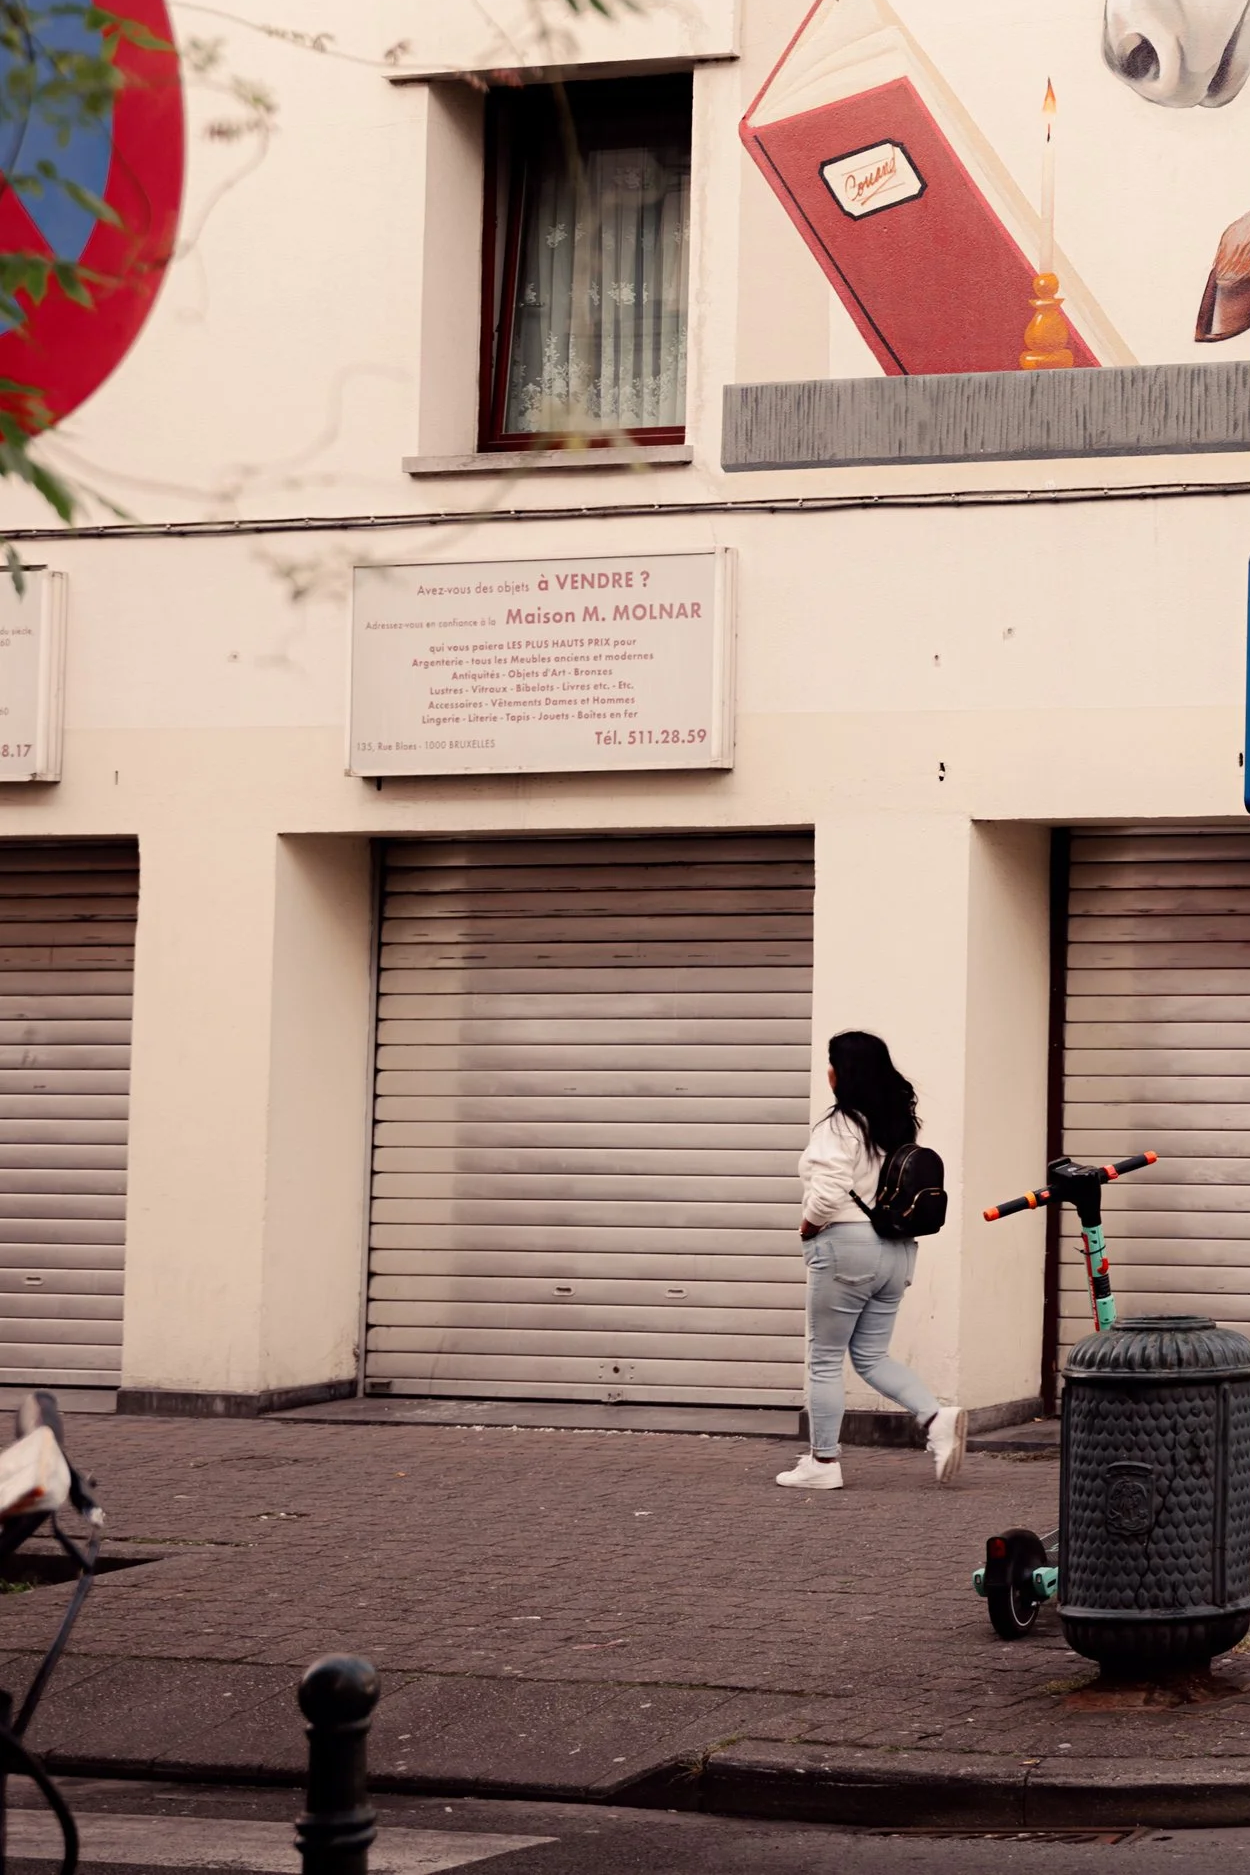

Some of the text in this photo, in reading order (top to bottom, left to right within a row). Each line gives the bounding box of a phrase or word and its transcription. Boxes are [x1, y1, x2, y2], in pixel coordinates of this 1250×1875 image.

[417, 571, 650, 596] Avez-vous des objets à VENDRE ?
[365, 621, 423, 630] Adressez-vous
[438, 618, 477, 628] confiance
[506, 608, 575, 625] Maison
[583, 606, 606, 622] M.
[613, 602, 702, 621] MOLNAR
[429, 643, 445, 654] qui
[472, 643, 504, 654] paiera
[507, 641, 522, 650] LES
[525, 639, 549, 649] PLUS
[552, 639, 585, 648] HAUTS
[588, 638, 610, 647] PRIX
[613, 638, 636, 650] pour
[412, 651, 654, 669] Argenterie tous les Meubles anciens et modernes
[452, 667, 613, 681] Antiquités Objets d'Art Bronzes
[430, 681, 634, 695] Lustres Vitraux Bibelots Livres etc. Etc.
[428, 695, 635, 710] Accessoires Vêtements Dames et Hommes
[422, 715, 460, 726] Lingerie
[468, 713, 498, 723] Literie
[506, 712, 530, 724] Tapis
[538, 711, 569, 720] Jouets
[578, 710, 607, 719] Boîtes
[624, 709, 638, 718] fer
[378, 742, 393, 751] Rue
[425, 740, 447, 749] 1000
[449, 739, 496, 749] BRUXELLES
[595, 729, 707, 746] Tél. 511.28.59
[0, 744, 32, 757] 8.17
